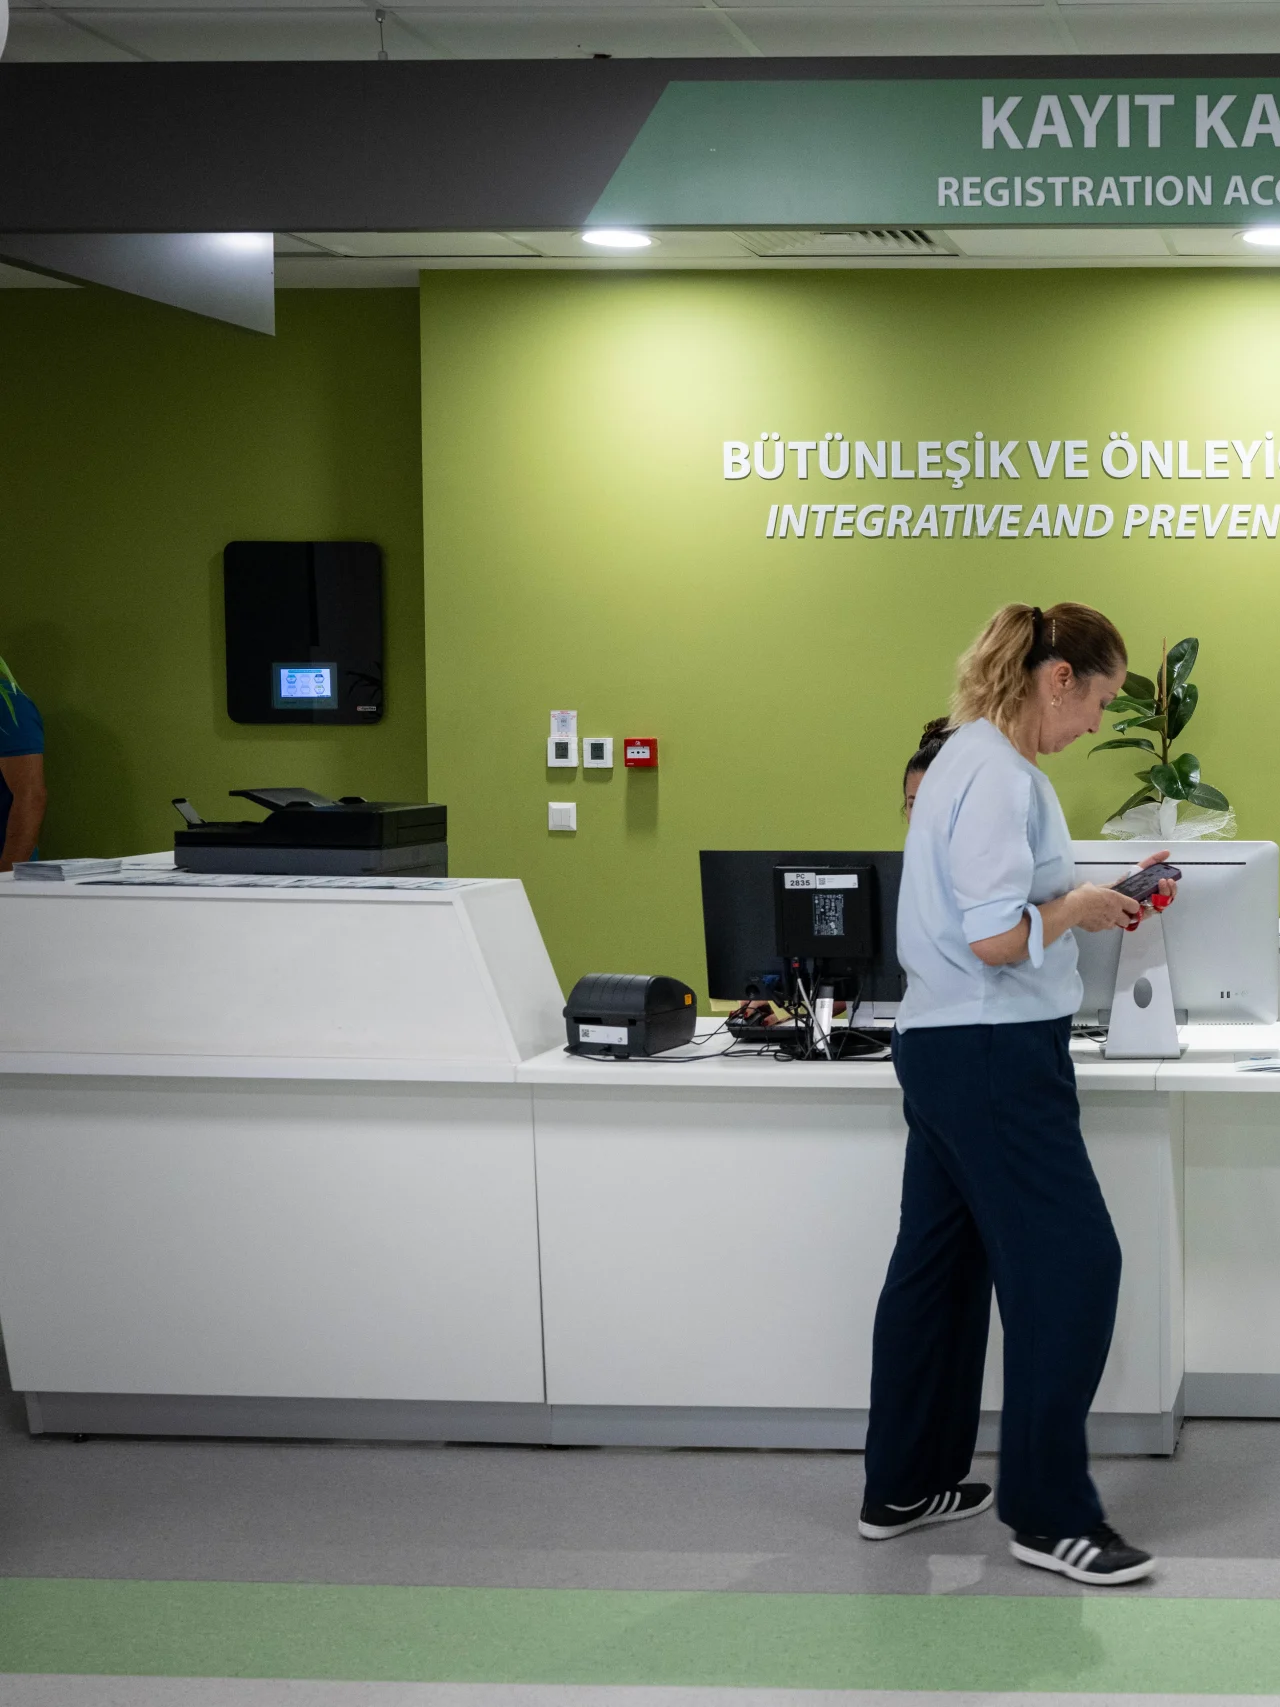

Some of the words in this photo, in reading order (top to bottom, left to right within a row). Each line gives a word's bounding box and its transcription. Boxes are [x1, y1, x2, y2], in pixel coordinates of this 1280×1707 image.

[981, 94, 1175, 149] KAYIT
[937, 175, 1213, 207] REGISTRATION
[723, 431, 1019, 489] BÜTÜNLEŞİK
[1027, 440, 1089, 479] VE
[765, 504, 1022, 538] INTEGRATIVE
[1024, 504, 1114, 538] AND
